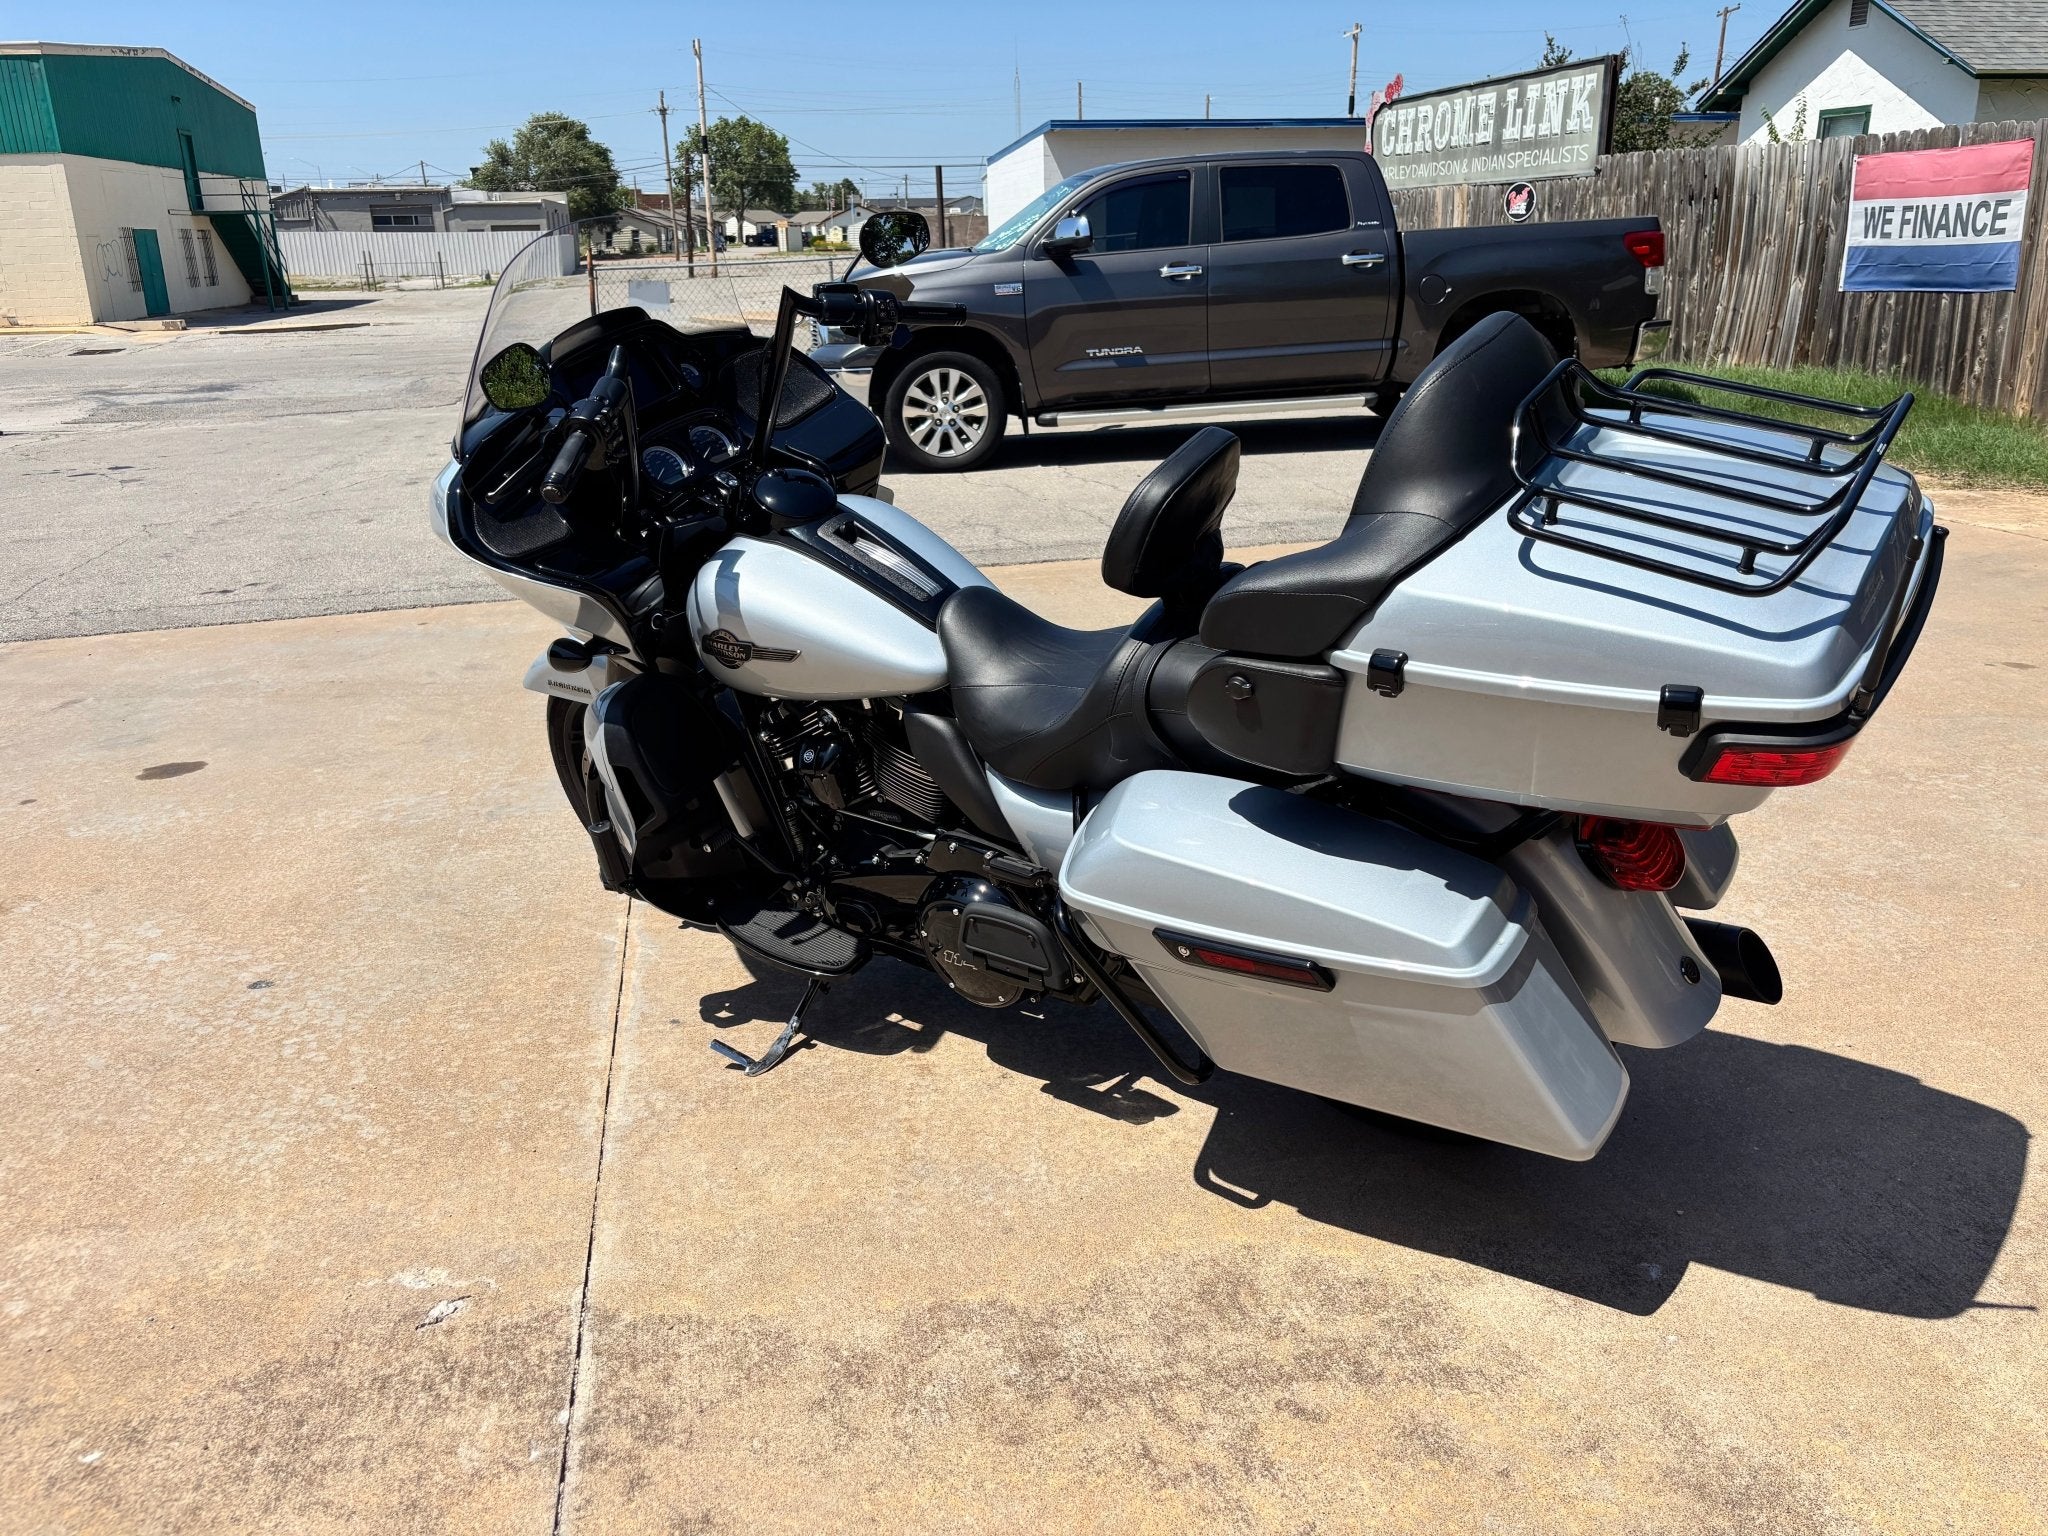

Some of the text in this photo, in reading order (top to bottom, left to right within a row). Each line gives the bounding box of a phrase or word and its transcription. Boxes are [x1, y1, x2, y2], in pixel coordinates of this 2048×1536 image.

[1381, 73, 1598, 157] CHROME LINK
[1381, 164, 1412, 180] ARLEY
[1461, 158, 1469, 173] &
[1471, 154, 1506, 173] INDIAN
[1507, 144, 1590, 169] SPECIALISTS
[1863, 199, 2012, 239] WE FINANCE
[1086, 346, 1143, 357] TUNDRA
